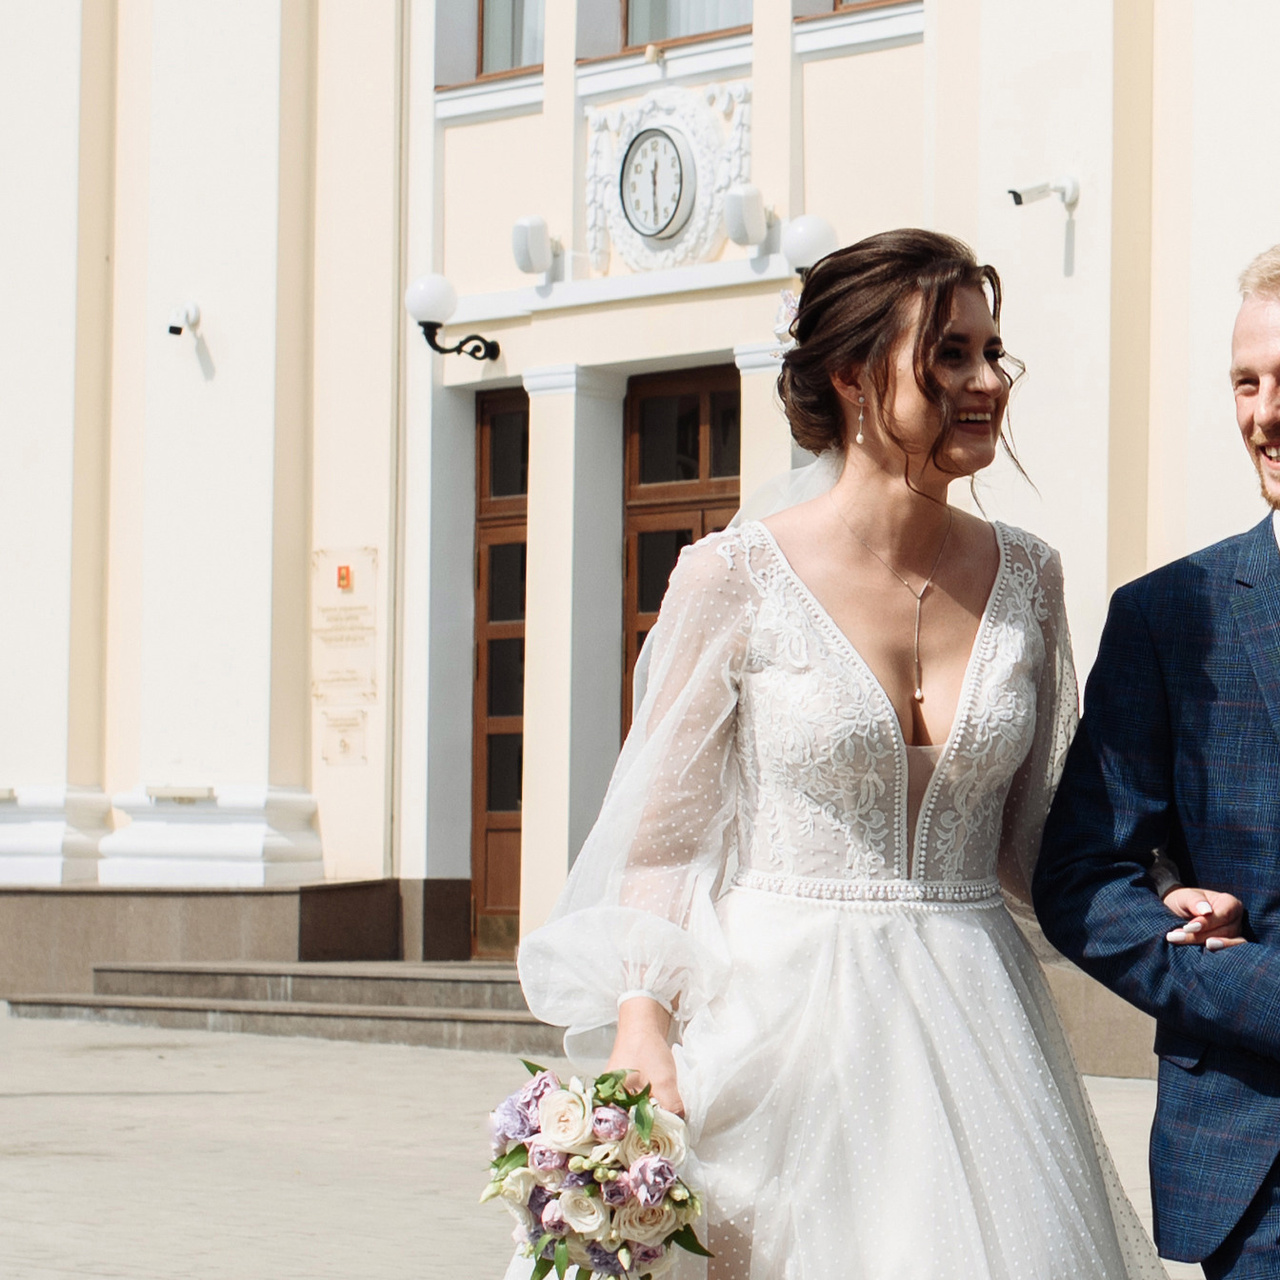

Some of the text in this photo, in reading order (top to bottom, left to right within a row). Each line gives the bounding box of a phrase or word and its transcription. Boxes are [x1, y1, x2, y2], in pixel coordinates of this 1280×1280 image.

[651, 140, 659, 152] 12
[664, 143, 667, 155] 1
[671, 156, 677, 169] 2
[634, 163, 642, 175] 10
[671, 192, 677, 203] 4
[643, 210, 648, 222] 7
[663, 207, 669, 219] 5
